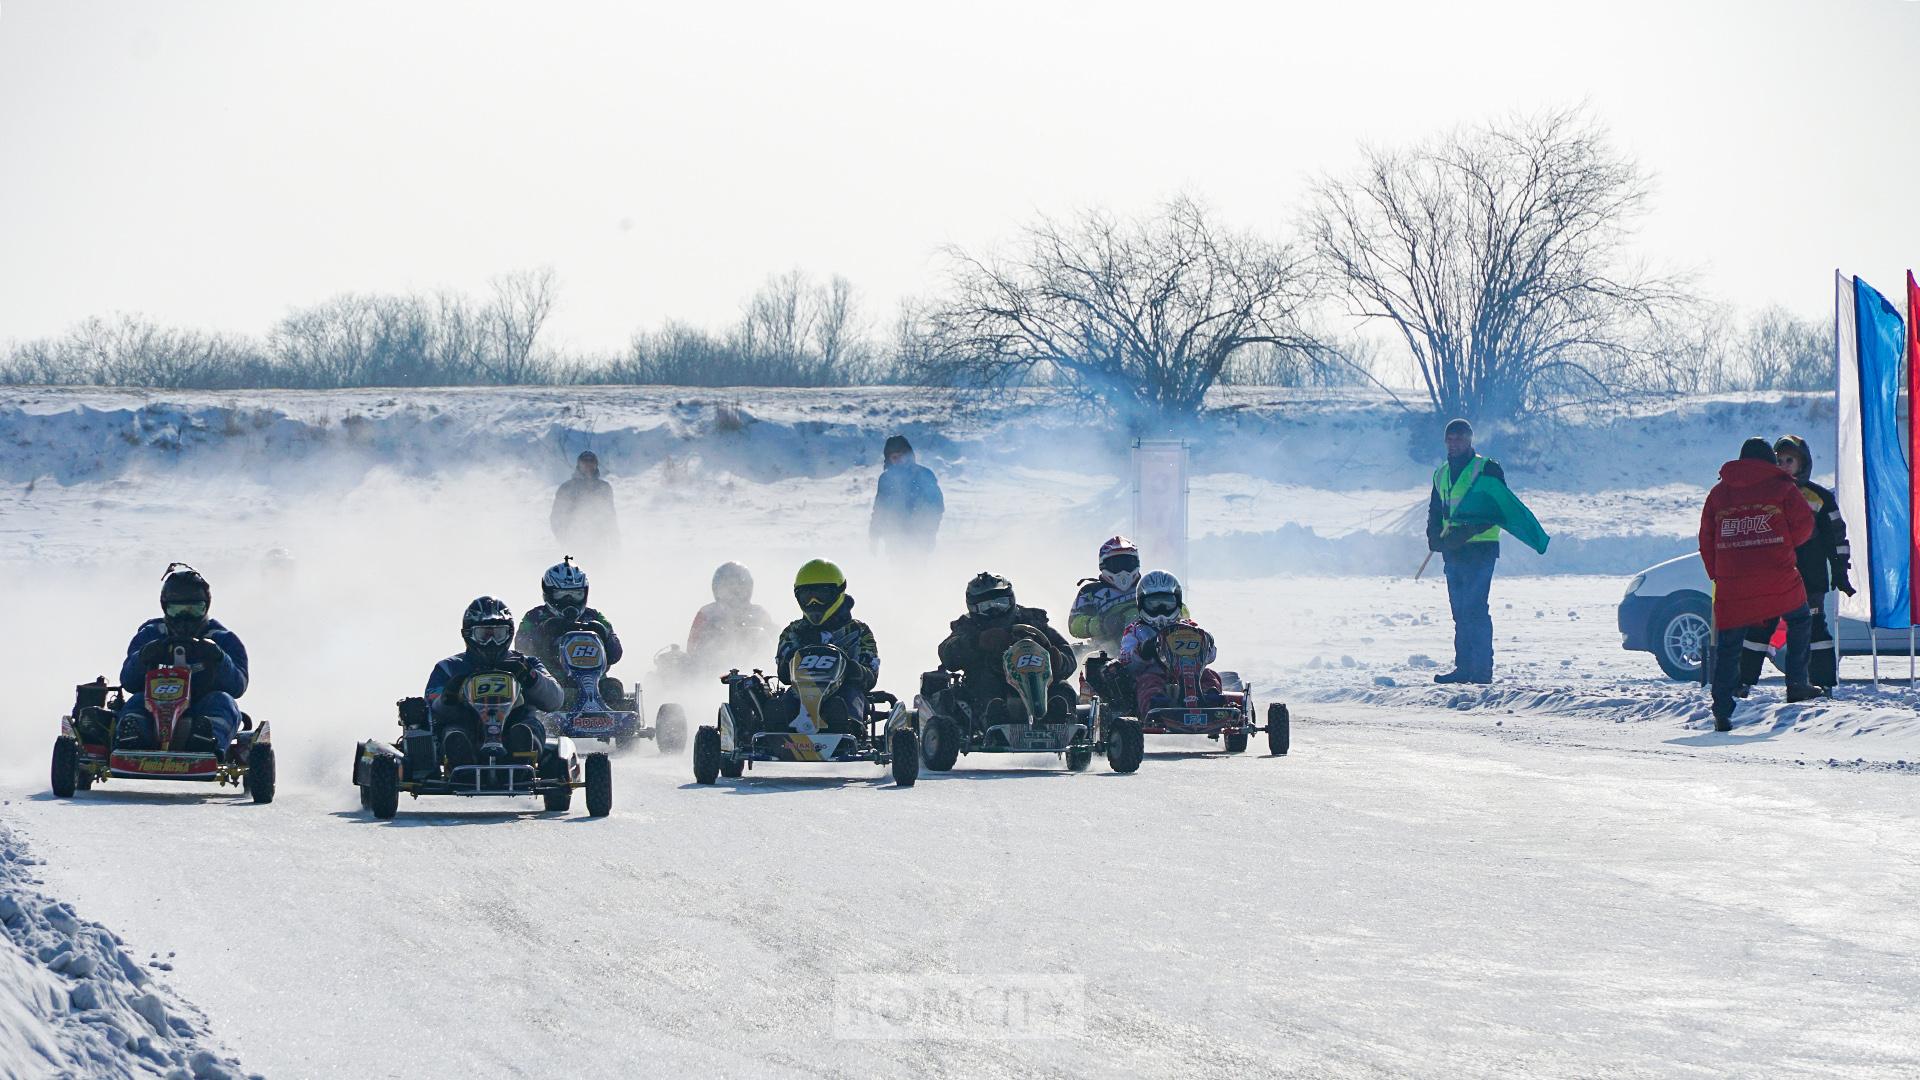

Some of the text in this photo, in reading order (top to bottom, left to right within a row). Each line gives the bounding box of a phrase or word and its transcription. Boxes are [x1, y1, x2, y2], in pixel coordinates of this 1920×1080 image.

[1174, 640, 1200, 650] 70
[571, 645, 599, 658] 69
[798, 654, 838, 669] 96
[1016, 654, 1044, 668] 65
[154, 684, 182, 694] 66
[477, 683, 506, 694] 97
